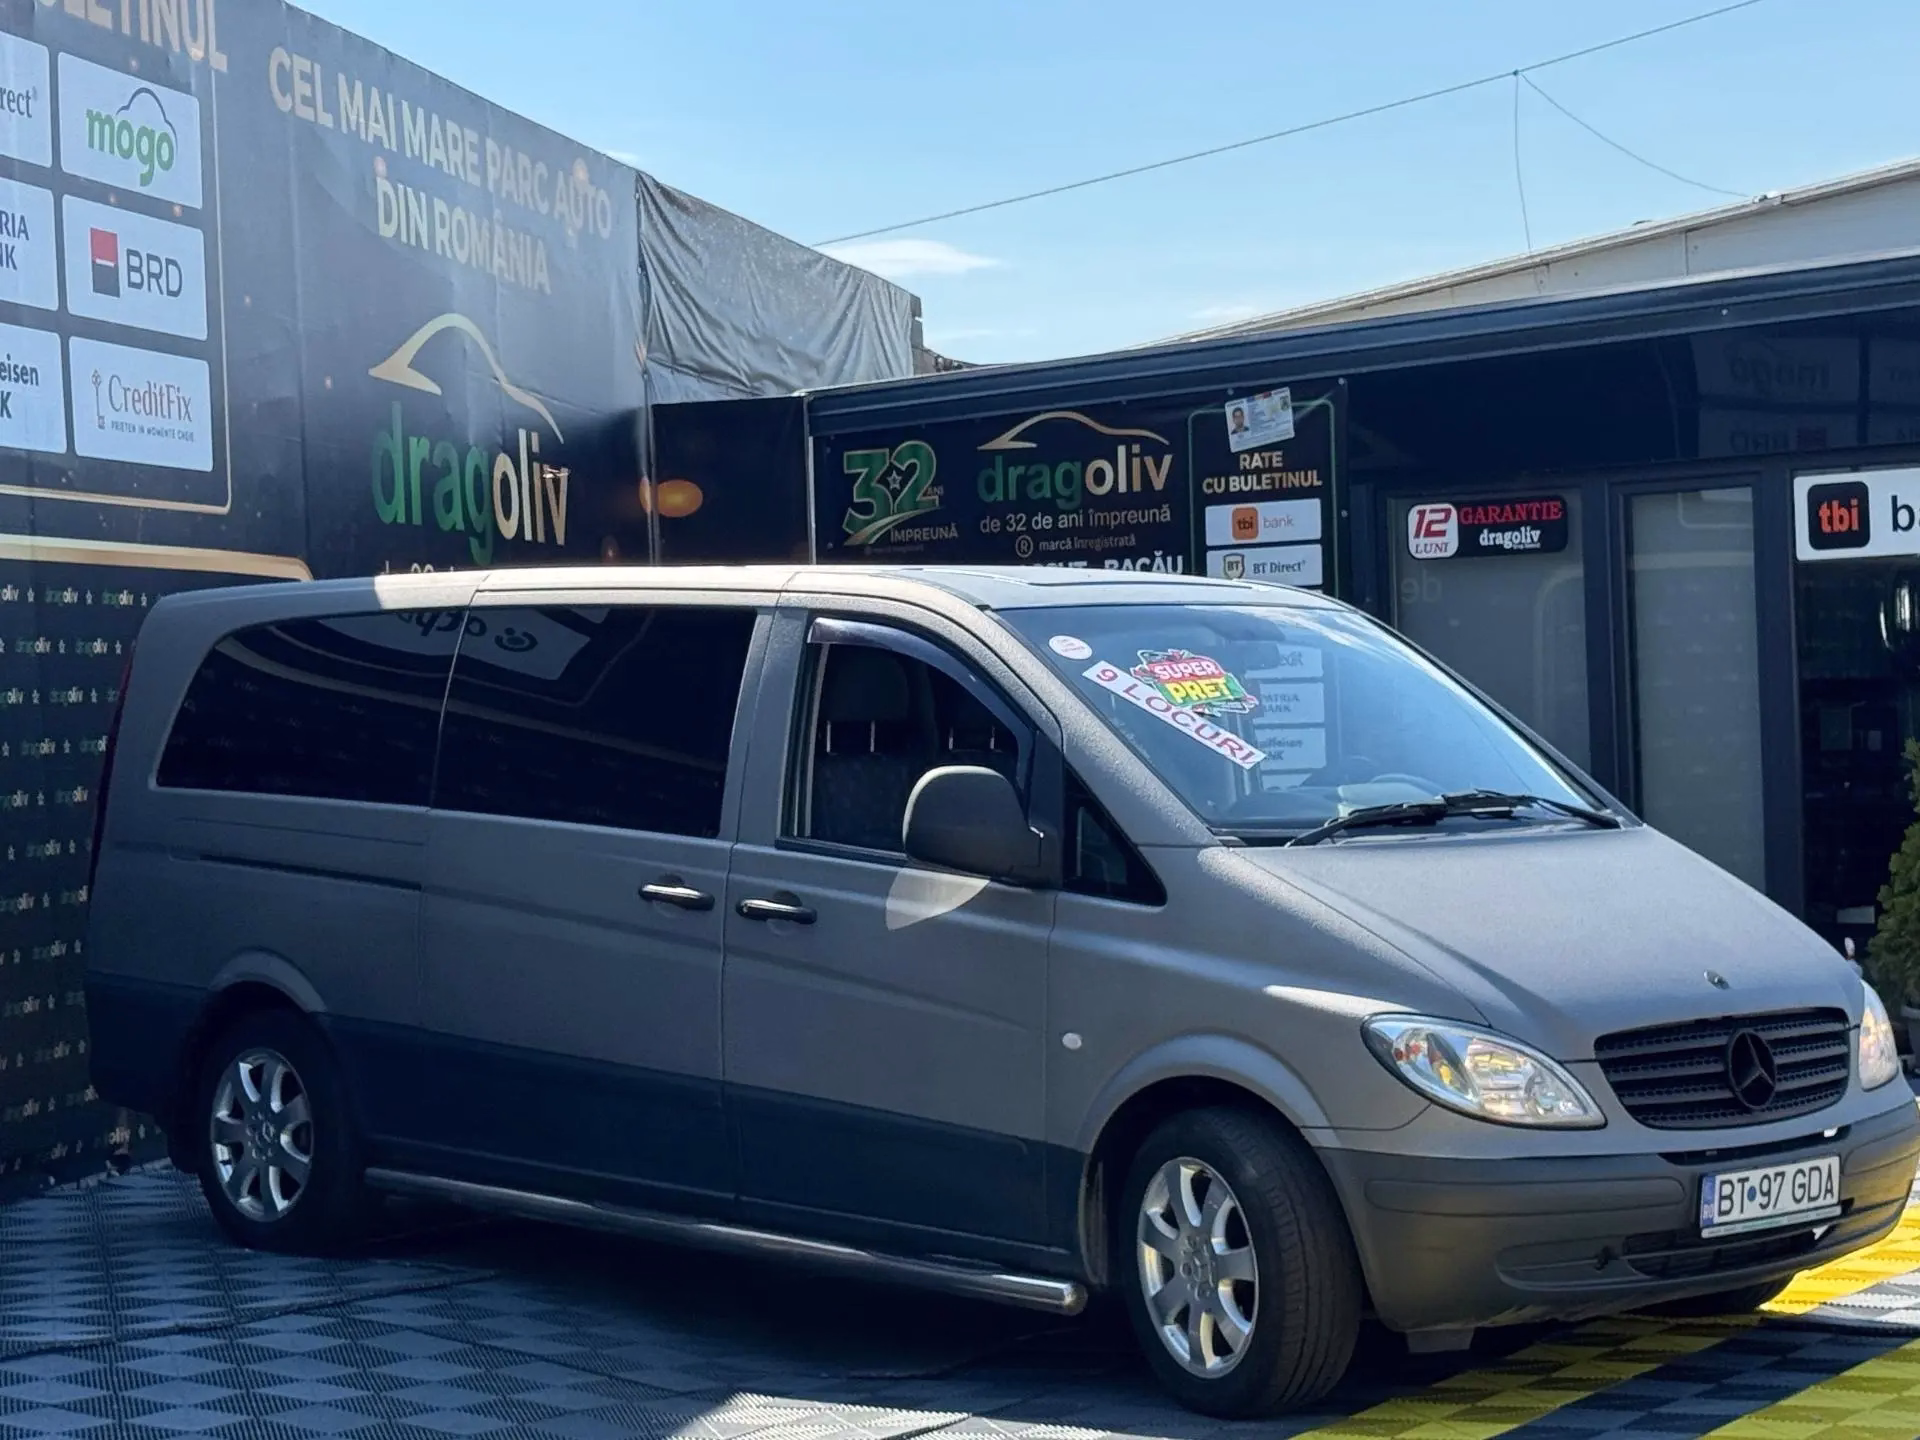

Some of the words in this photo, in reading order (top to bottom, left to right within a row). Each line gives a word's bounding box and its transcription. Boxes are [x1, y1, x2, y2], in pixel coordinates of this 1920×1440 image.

[86, 108, 175, 187] mogo
[269, 46, 333, 129] CEL
[338, 72, 397, 152] MAI
[401, 99, 482, 187] MARE
[486, 137, 548, 215] PARC
[554, 169, 612, 239] AUTO
[376, 176, 429, 251] DIN
[434, 197, 552, 295] ROMÂNIA
[127, 249, 182, 298] BRD
[108, 374, 193, 422] CreditFix
[1239, 451, 1283, 470] RATE
[371, 401, 569, 566] dragoliv
[842, 440, 938, 535] 32
[977, 444, 1173, 510] dragoliv
[1202, 477, 1225, 494] CU
[1228, 469, 1323, 492] BULETINUL
[980, 516, 1000, 533] de
[1006, 513, 1027, 531] 32
[1031, 512, 1053, 530] de
[1058, 509, 1083, 529] ani
[1088, 504, 1171, 529] împreună
[1237, 517, 1253, 531] tbi
[1263, 515, 1294, 529] bank
[1413, 507, 1452, 539] 12
[1460, 501, 1563, 525] GARANTIE
[1818, 497, 1860, 534] tbi
[1891, 495, 1920, 532] b
[890, 522, 959, 543] ÎMPREUNĂ
[1479, 526, 1541, 549] dragoliv
[1414, 542, 1448, 554] LUNI
[1226, 560, 1240, 572] BT
[1253, 563, 1267, 575] BT
[1154, 661, 1219, 680] SUPER
[1165, 676, 1232, 704] PRET
[1095, 667, 1119, 682] 9
[1123, 683, 1257, 764] LOCURI
[1718, 1176, 1750, 1217] BT
[1758, 1170, 1786, 1210] 97
[1792, 1163, 1834, 1204] GDA
